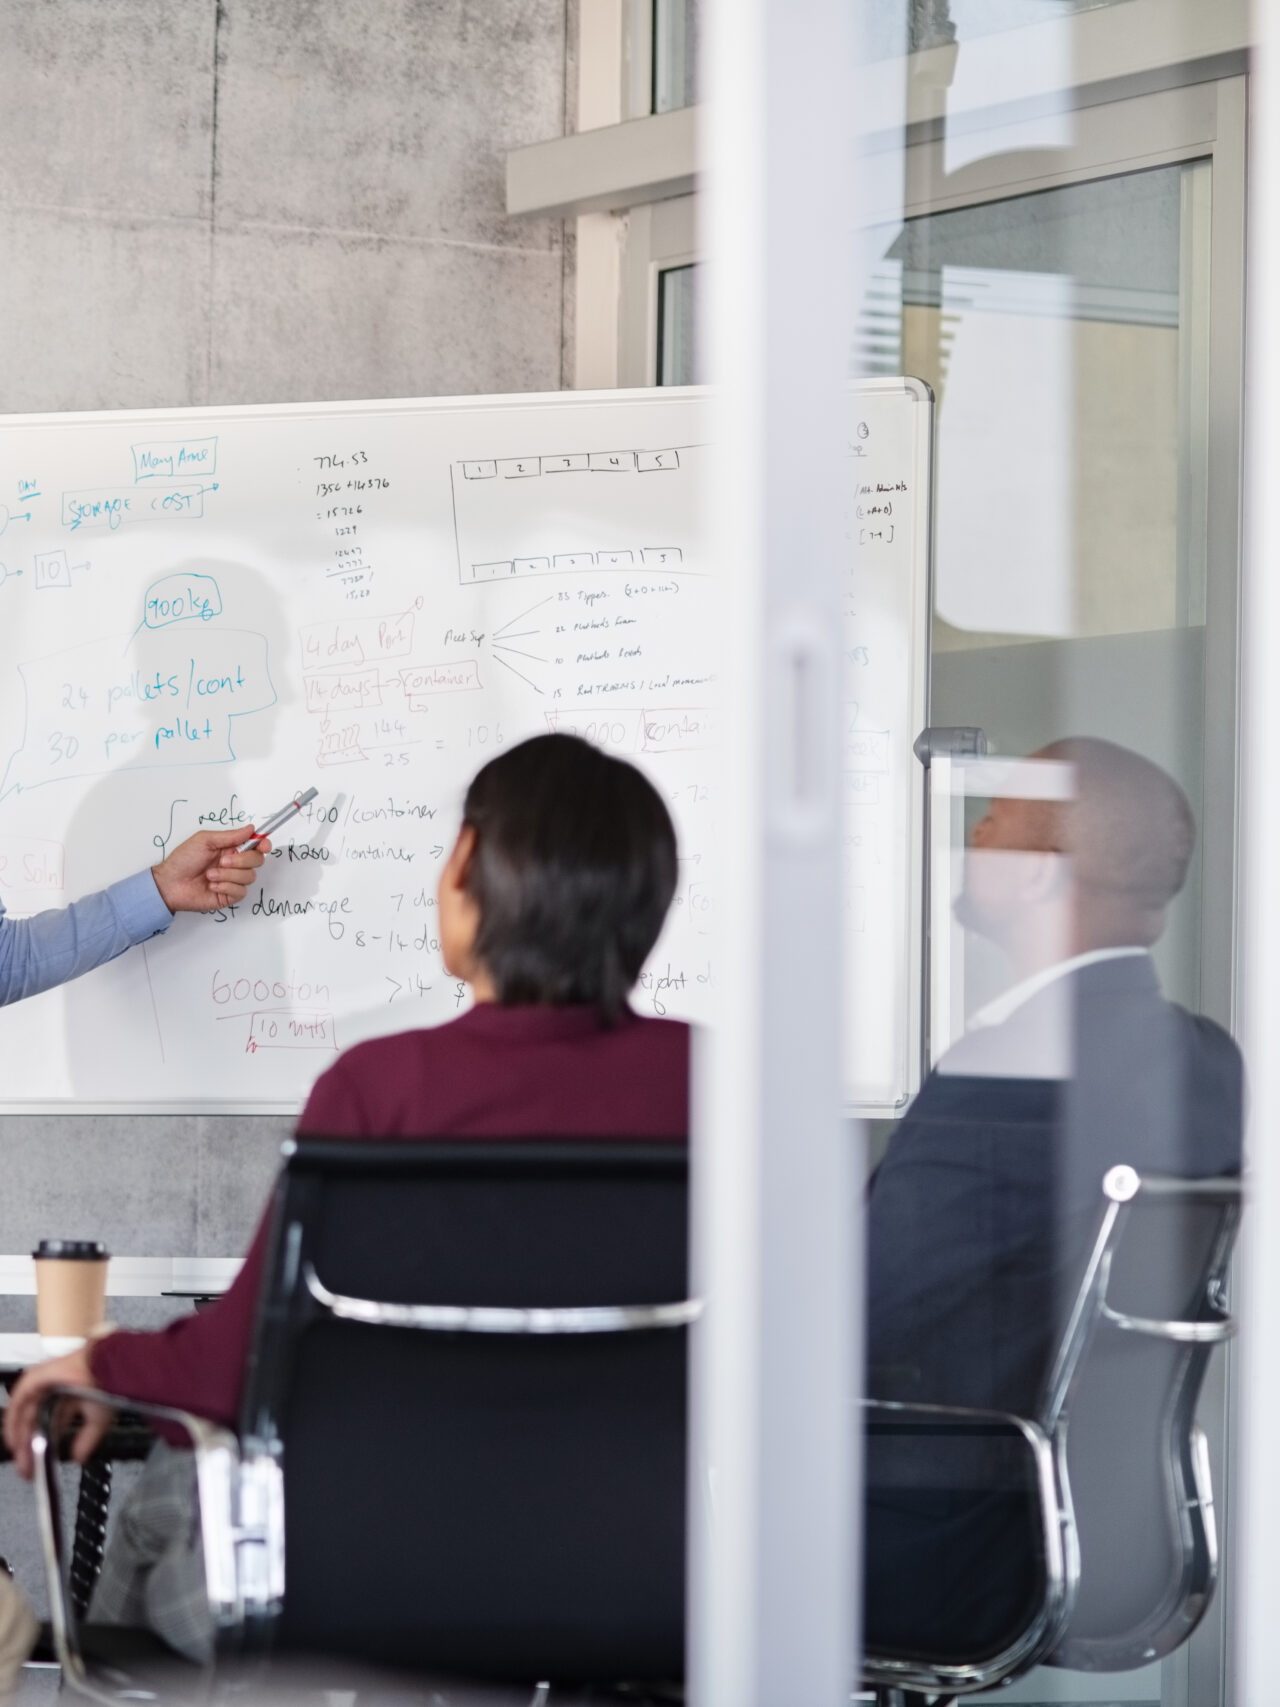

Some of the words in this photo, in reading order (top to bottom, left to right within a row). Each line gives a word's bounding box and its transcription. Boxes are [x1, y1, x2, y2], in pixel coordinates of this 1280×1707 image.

[61, 683, 89, 710] 24
[48, 731, 80, 766] 30
[104, 730, 144, 760] per
[155, 717, 213, 750] pallet
